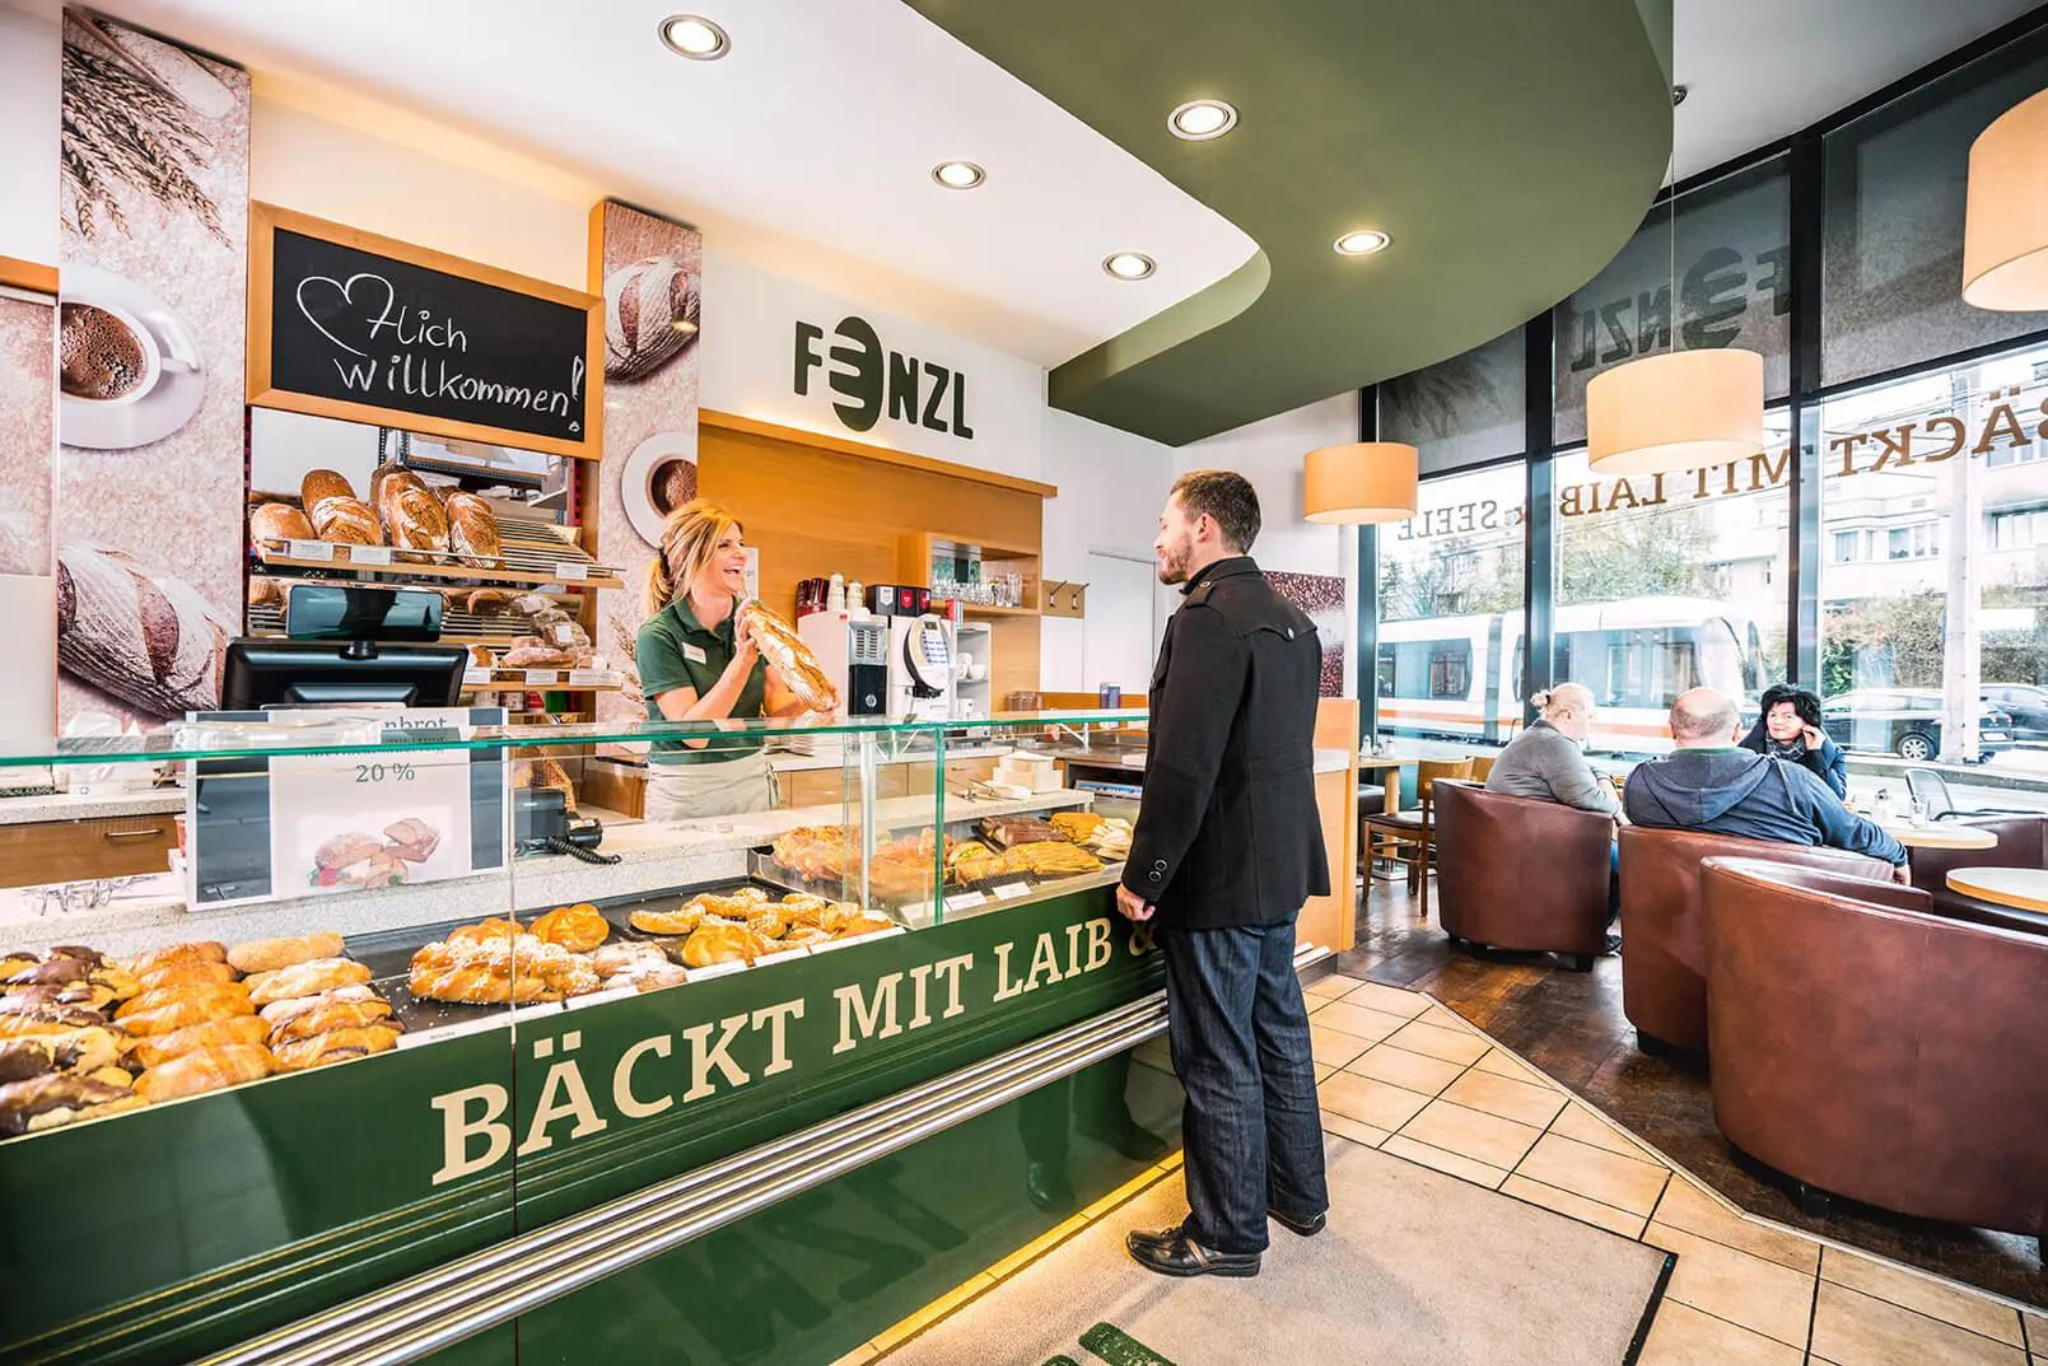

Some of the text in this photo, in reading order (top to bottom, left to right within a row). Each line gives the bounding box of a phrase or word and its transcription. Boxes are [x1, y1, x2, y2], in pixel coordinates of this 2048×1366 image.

[794, 316, 974, 440] FENZL
[355, 762, 416, 783] 20 %
[431, 998, 805, 1186] BÄCKT
[832, 953, 974, 1055] MIT
[993, 917, 1113, 1003] LAIB
